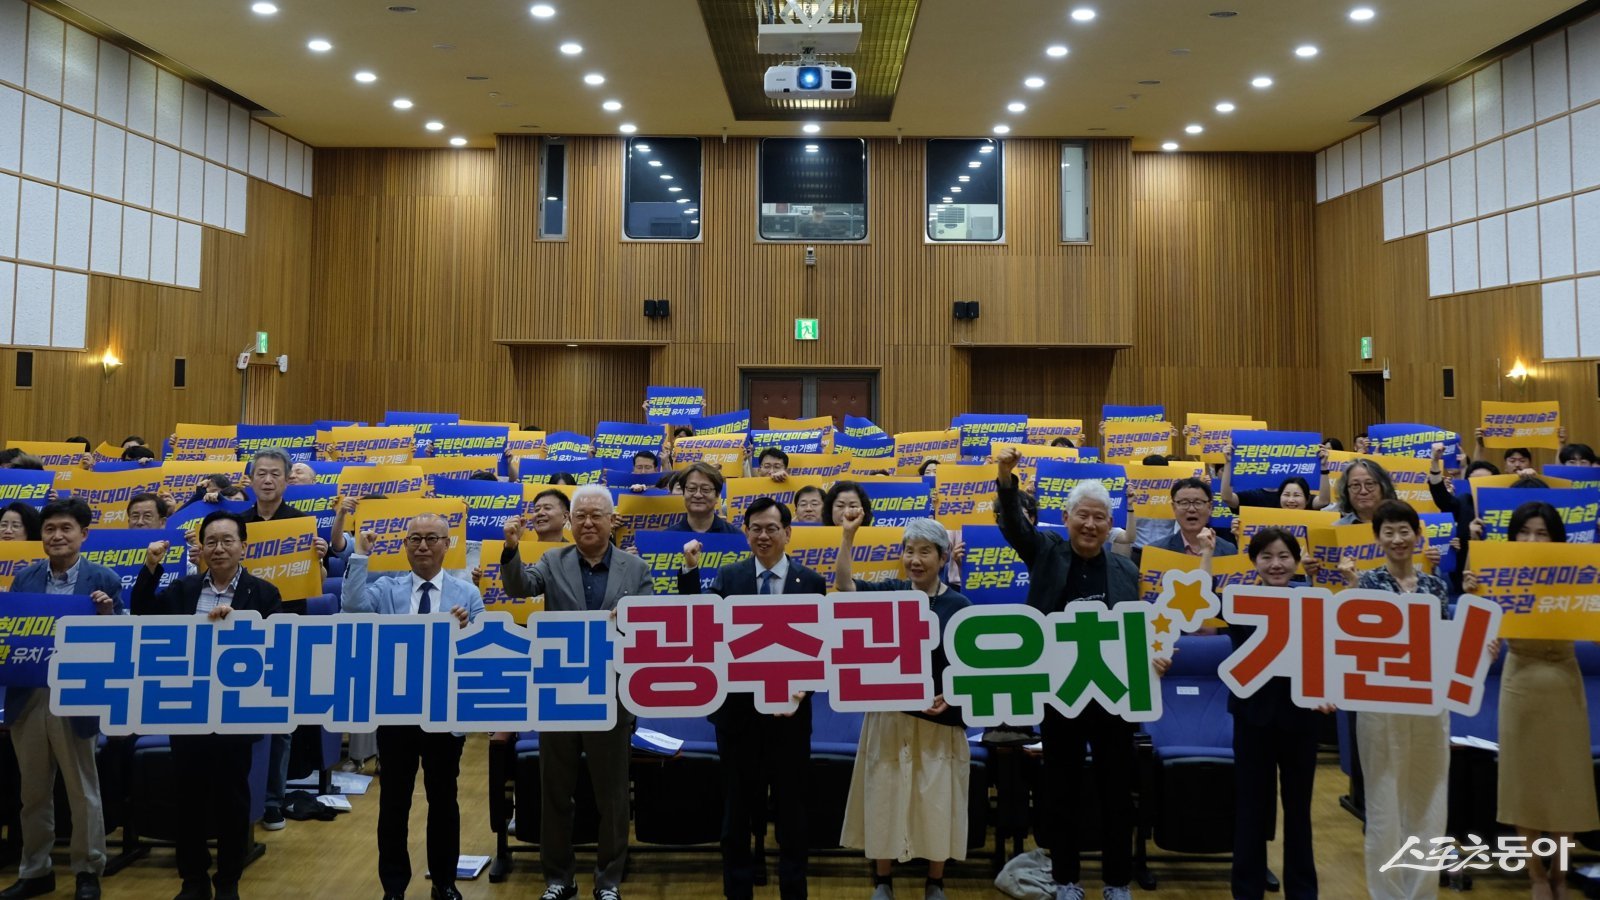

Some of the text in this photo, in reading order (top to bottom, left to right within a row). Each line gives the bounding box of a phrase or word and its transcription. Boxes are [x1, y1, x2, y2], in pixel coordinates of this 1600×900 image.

[649, 396, 702, 405] 국립현대미술관
[1484, 411, 1557, 424] 국립현대미술관
[962, 422, 1027, 434] 국립현대미술관
[1484, 427, 1514, 437] 광주관
[239, 436, 315, 449] 국립현대미술관
[434, 436, 506, 449] 국립현대미술관
[597, 434, 662, 446] 국립현대미술관
[754, 431, 821, 442] 국립현대미술관
[962, 437, 989, 447] 광주관
[1107, 432, 1170, 444] 국립현대미술관
[1381, 431, 1456, 448] 국립현대미술관
[336, 437, 411, 452] 국립현대미술관
[677, 440, 742, 448] 국립현대미술관
[897, 440, 959, 452] 국립현대미술관
[1234, 444, 1320, 457] 국립현대미술관
[596, 448, 622, 458] 광주관
[675, 453, 702, 462] 광주관
[704, 453, 719, 461] 유치
[1107, 447, 1133, 457] 광주관
[897, 456, 923, 467] 광주관
[1233, 462, 1271, 475] 광주관
[1270, 464, 1291, 474] 유치
[340, 478, 422, 496] 국립현대미술관
[938, 501, 975, 515] 광주관
[103, 509, 126, 522] 유치
[468, 515, 487, 526] 유치
[367, 538, 403, 556] 주관
[792, 544, 903, 566] 국립현미술관
[651, 576, 679, 593] 주관
[966, 570, 1029, 589] 광주관 유
[1538, 595, 1569, 613] 유치
[11, 647, 44, 664] 유치
[57, 595, 1492, 725] 국립현대미술관 광주관 유치 기원!
